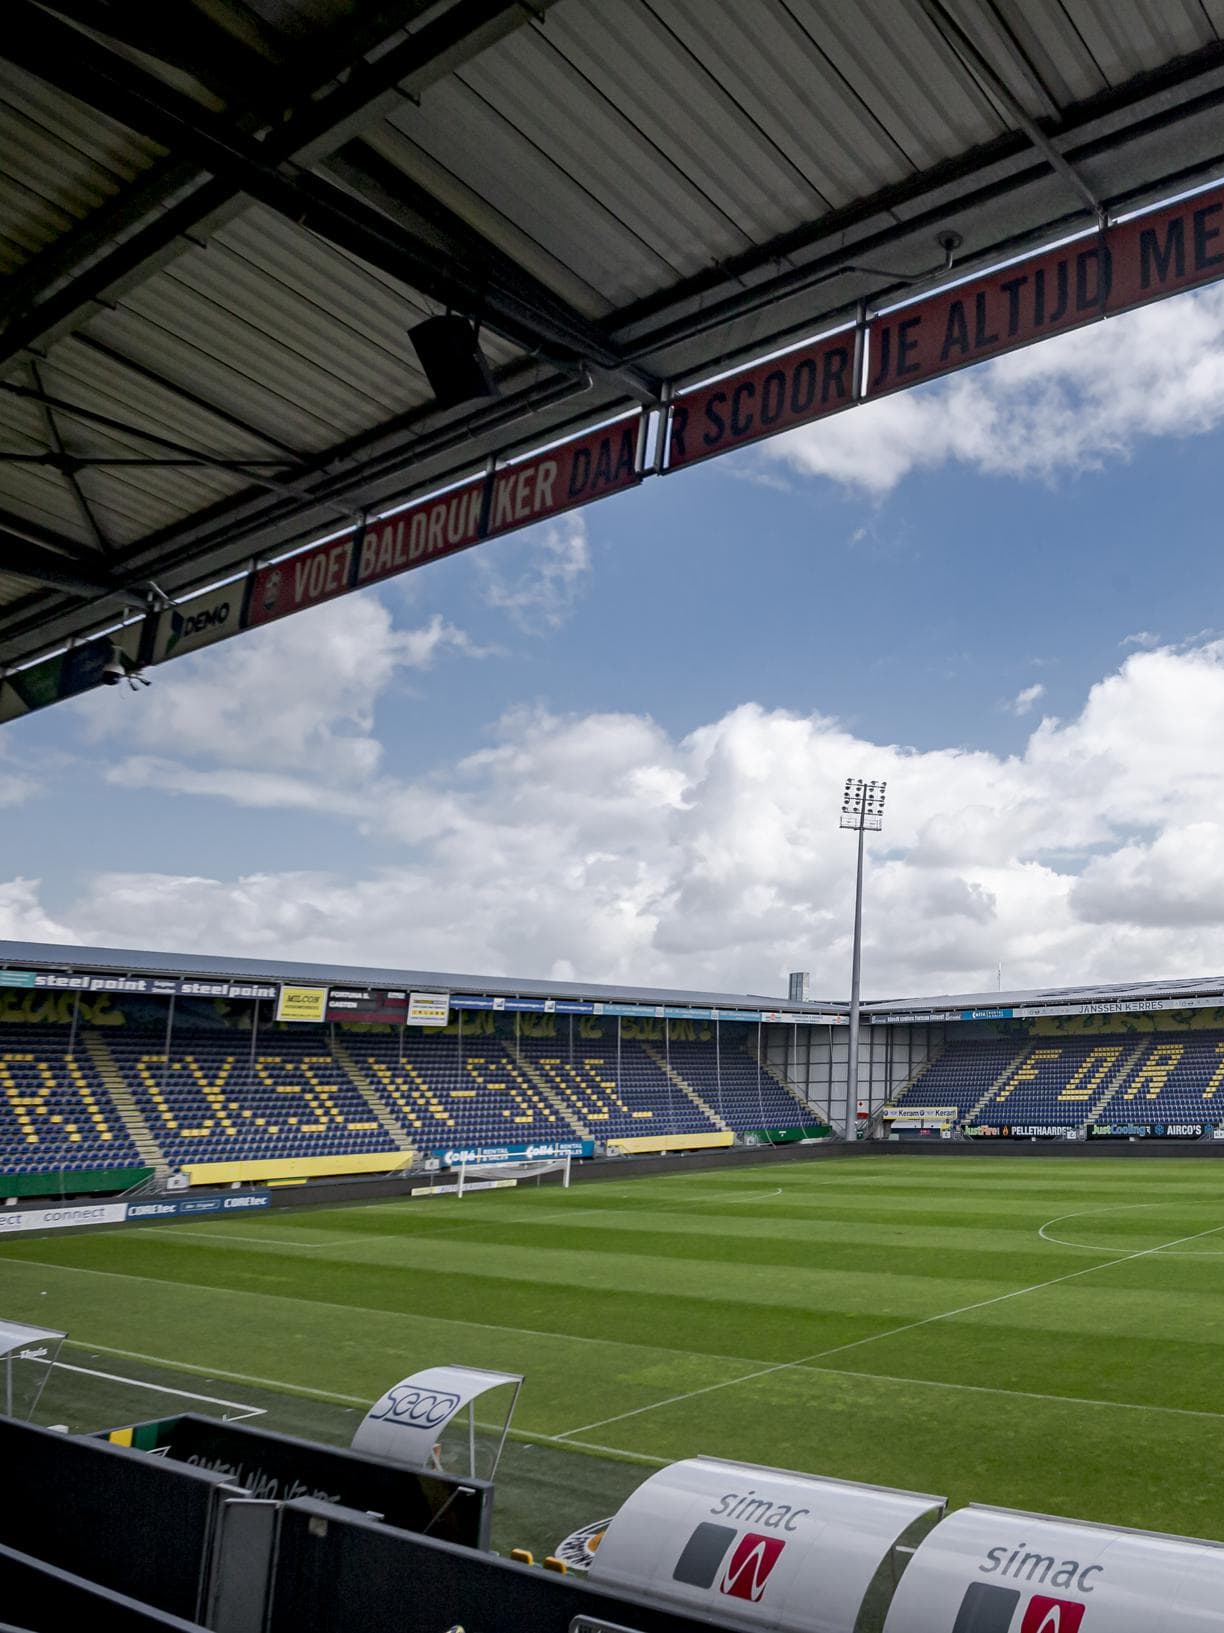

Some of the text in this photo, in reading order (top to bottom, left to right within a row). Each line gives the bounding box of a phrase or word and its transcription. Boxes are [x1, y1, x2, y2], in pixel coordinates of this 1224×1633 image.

[703, 346, 851, 447] SCOOR
[874, 315, 923, 386] JE
[940, 243, 1113, 361] ALTIJD
[182, 602, 231, 638] DEMO
[1078, 1004, 1122, 1014] JANSSEN
[1125, 1001, 1164, 1011] KERRES
[898, 1107, 920, 1117] Keram
[1166, 1125, 1202, 1136] AIRCO'S
[43, 1207, 105, 1222] connect
[710, 1489, 811, 1532] simac
[978, 1542, 1104, 1593] simac
